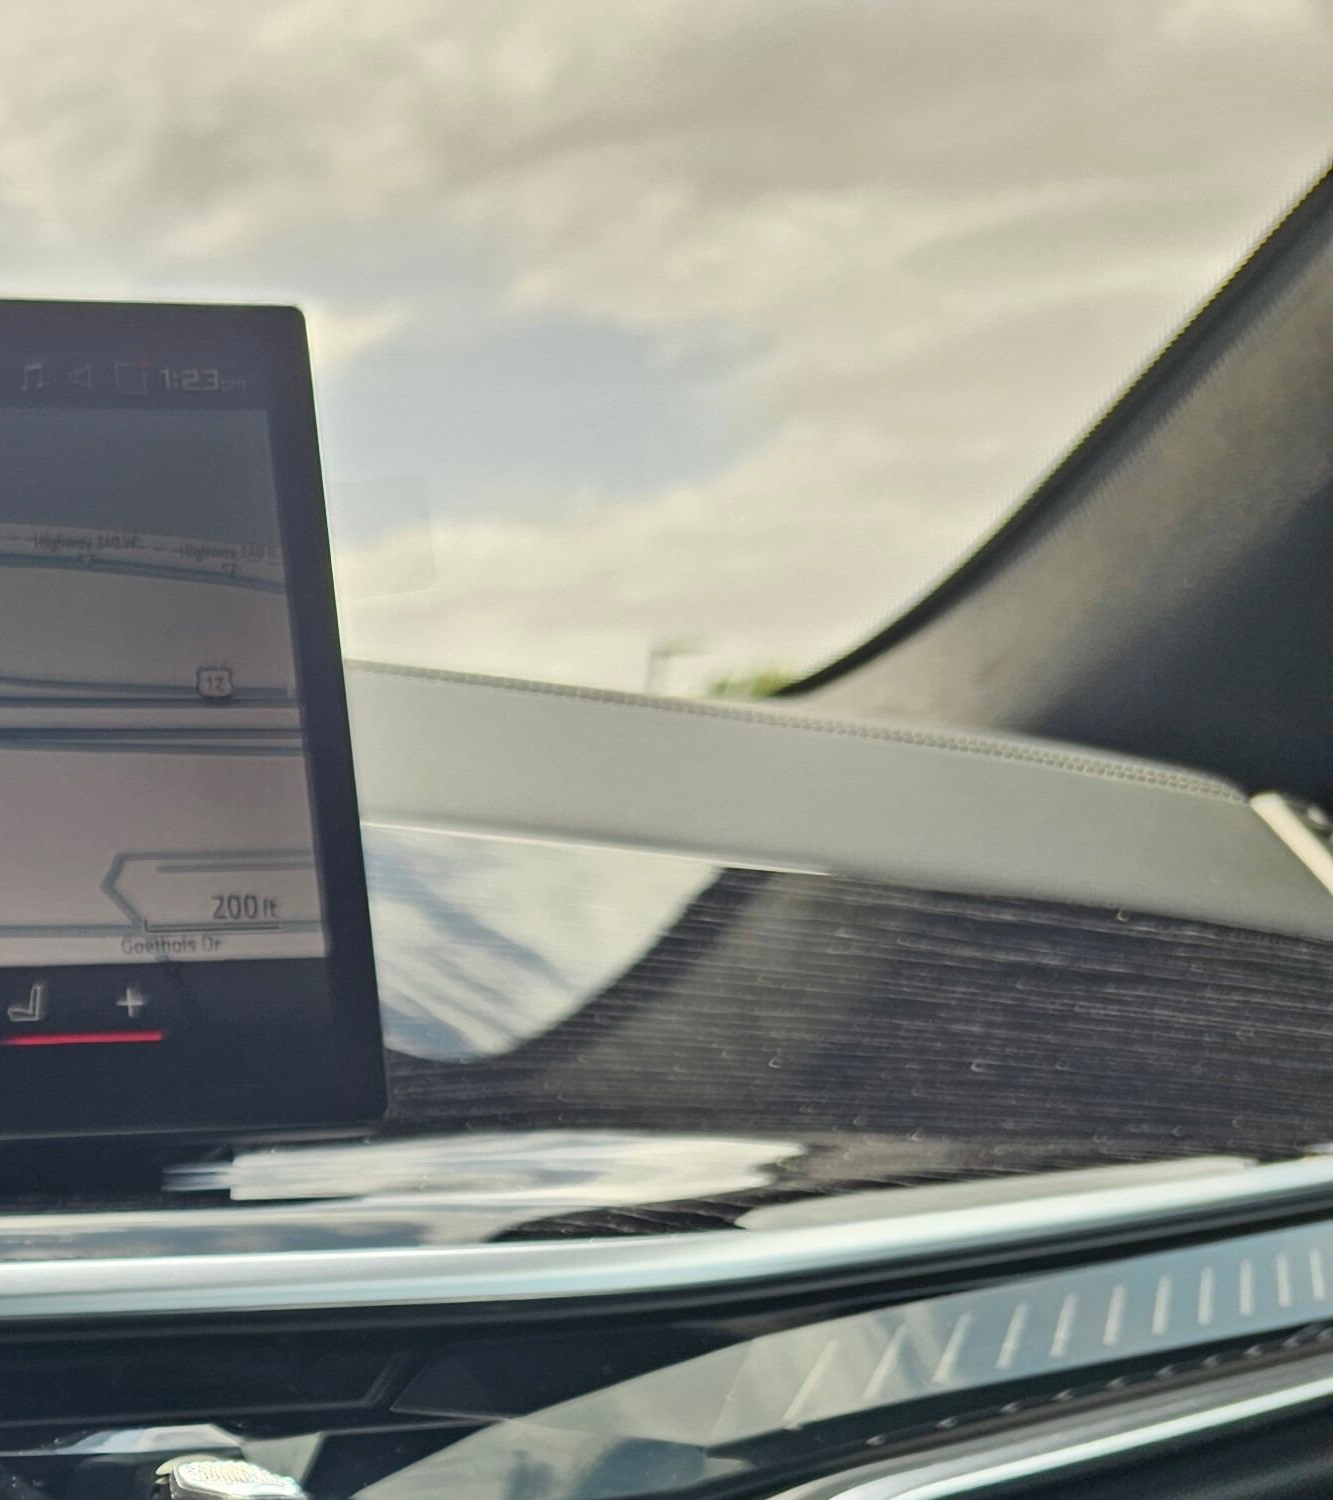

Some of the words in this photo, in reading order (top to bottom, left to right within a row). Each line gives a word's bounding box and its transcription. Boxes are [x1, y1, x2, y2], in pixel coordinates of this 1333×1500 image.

[159, 368, 219, 392] 1:23
[206, 676, 225, 692] 12
[211, 894, 258, 919] 200
[262, 896, 278, 918] ft
[201, 936, 222, 952] Dr
